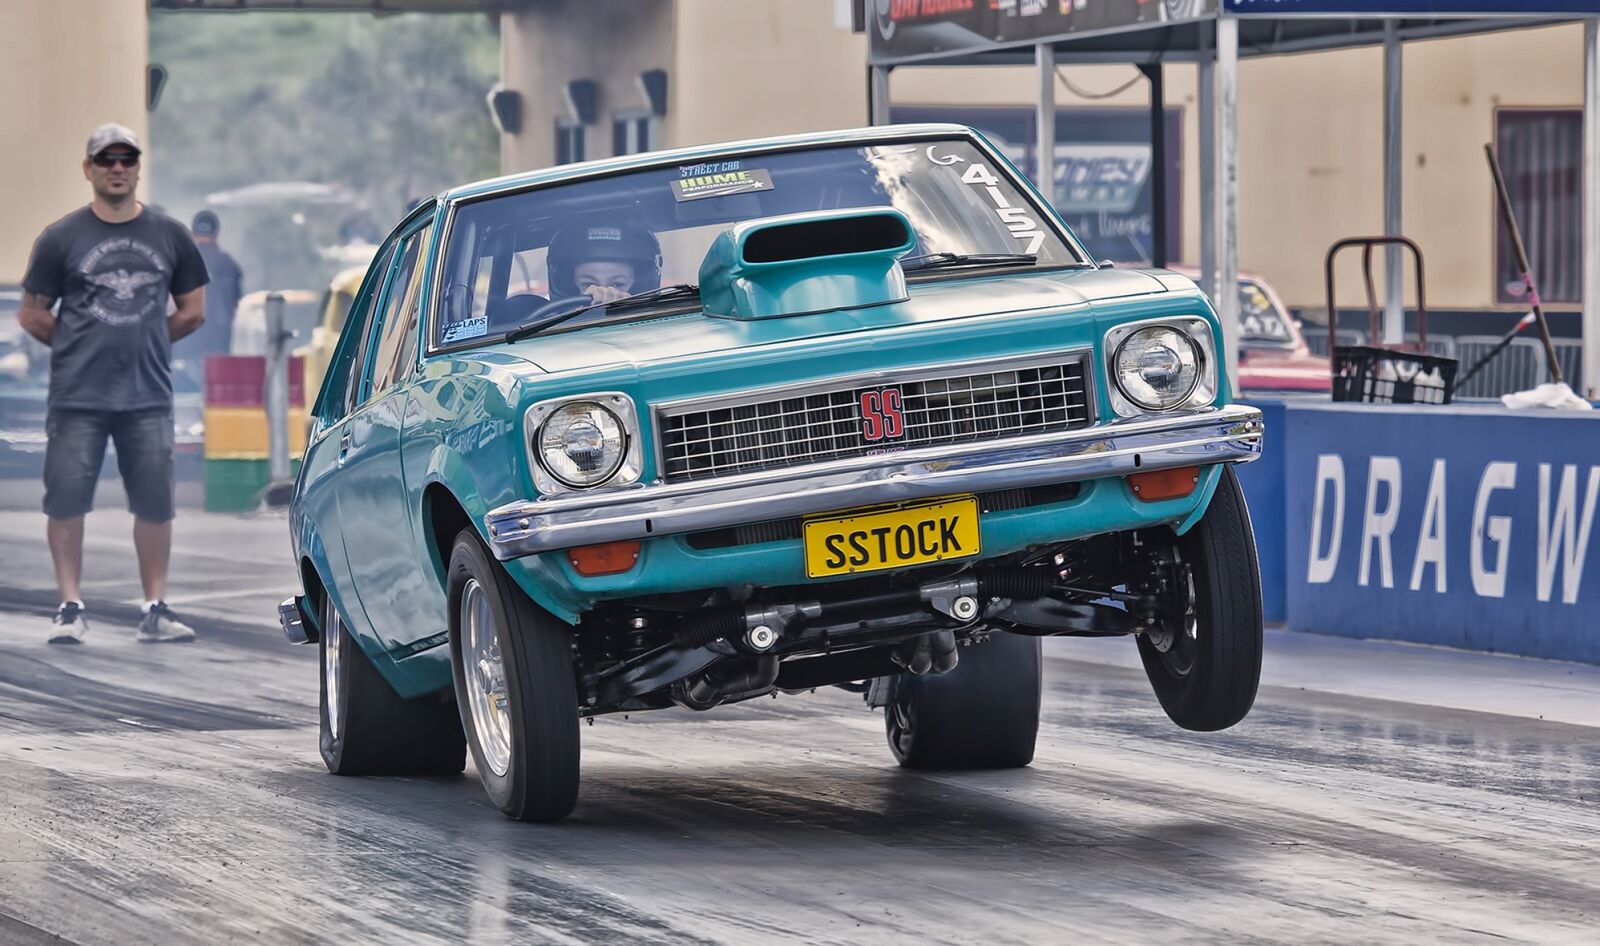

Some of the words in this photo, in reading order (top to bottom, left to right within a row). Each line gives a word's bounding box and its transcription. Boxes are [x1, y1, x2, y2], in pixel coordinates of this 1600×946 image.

[681, 163, 719, 178] STREET
[721, 160, 740, 172] CAR
[680, 172, 750, 188] HUME
[682, 179, 755, 193] PERFORMANCE
[961, 163, 1045, 254] 4157
[463, 317, 486, 328] LAPS
[860, 388, 904, 440] SS
[825, 516, 962, 569] SSTOCK
